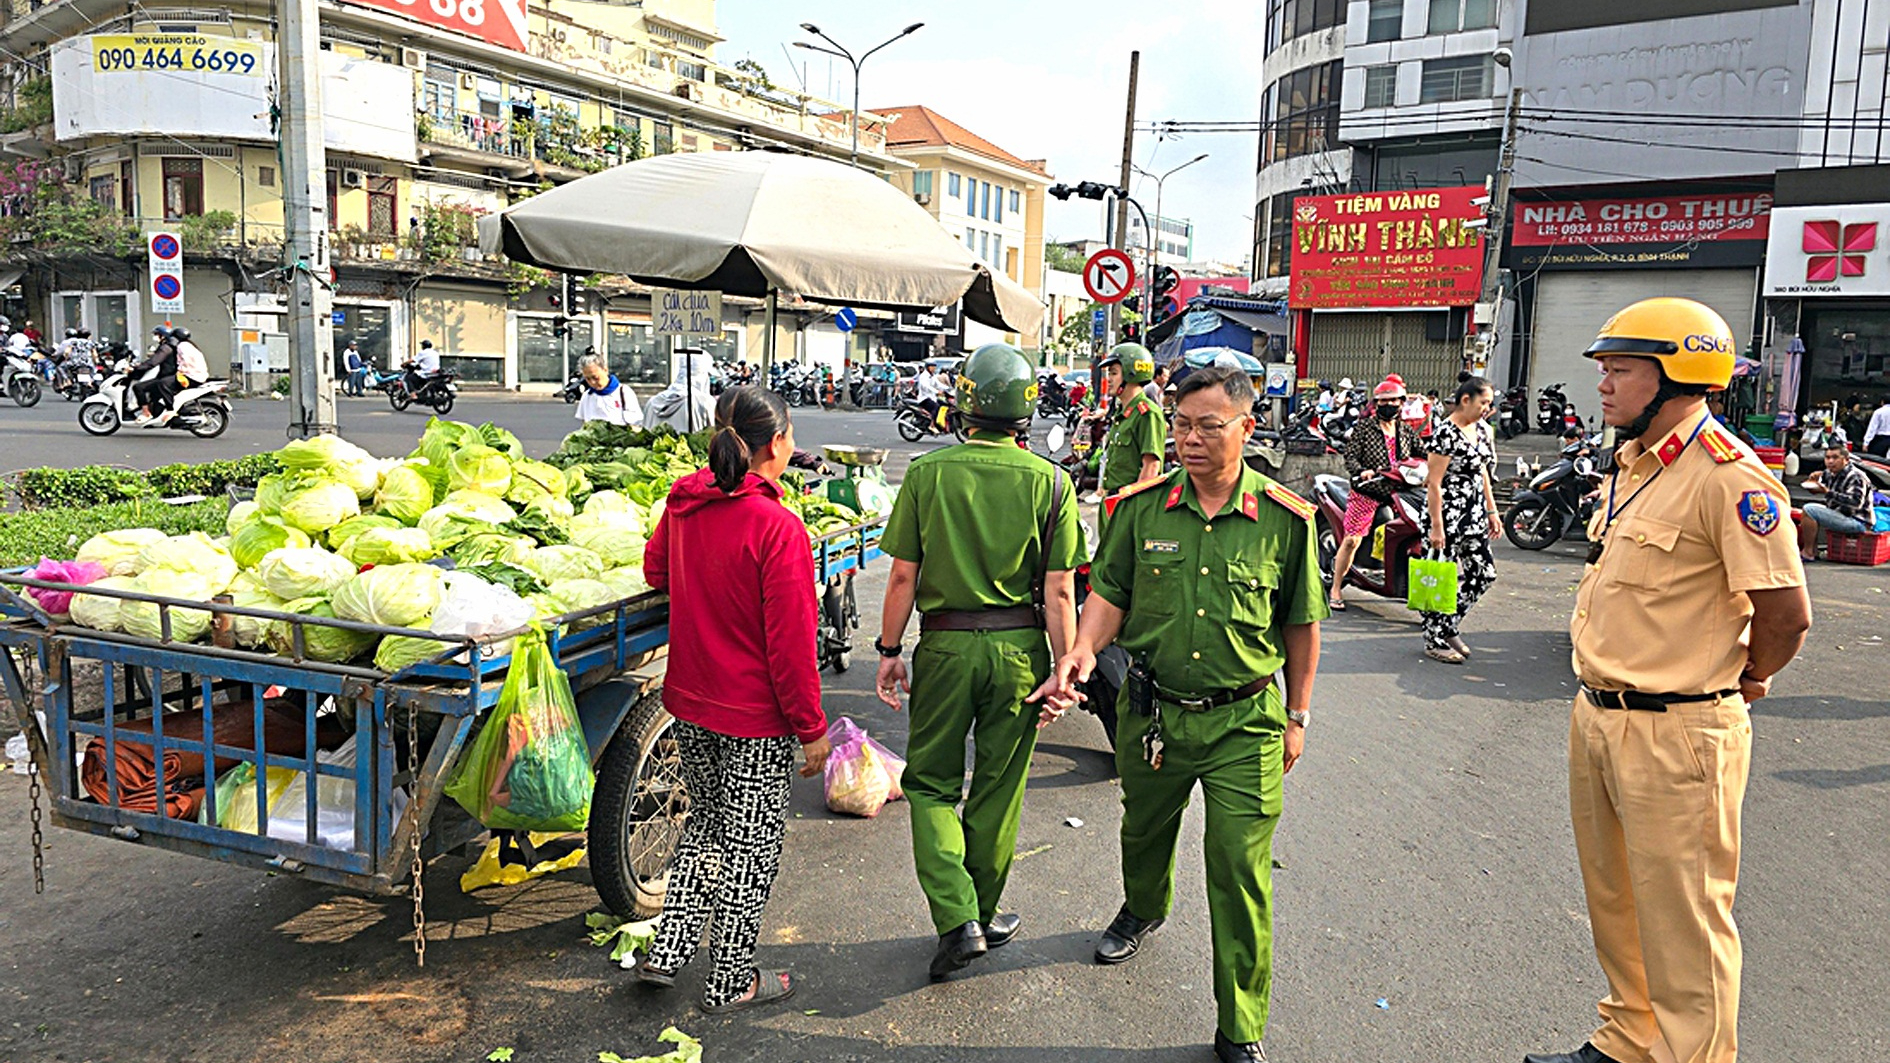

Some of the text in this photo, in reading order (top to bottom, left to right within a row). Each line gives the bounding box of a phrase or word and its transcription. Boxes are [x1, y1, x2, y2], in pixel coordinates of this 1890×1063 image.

[100, 47, 255, 74] 090 464 6699
[1334, 192, 1440, 216] TIỆM VÀNG
[1523, 193, 1774, 224] NHÀ CHO THUÊ
[1297, 213, 1477, 254] VĨNH THÀNH
[1561, 223, 1592, 235] 0934
[1596, 222, 1619, 233] 181
[1623, 221, 1649, 233] 678
[1660, 219, 1694, 232] 0903
[1698, 218, 1724, 231] 905
